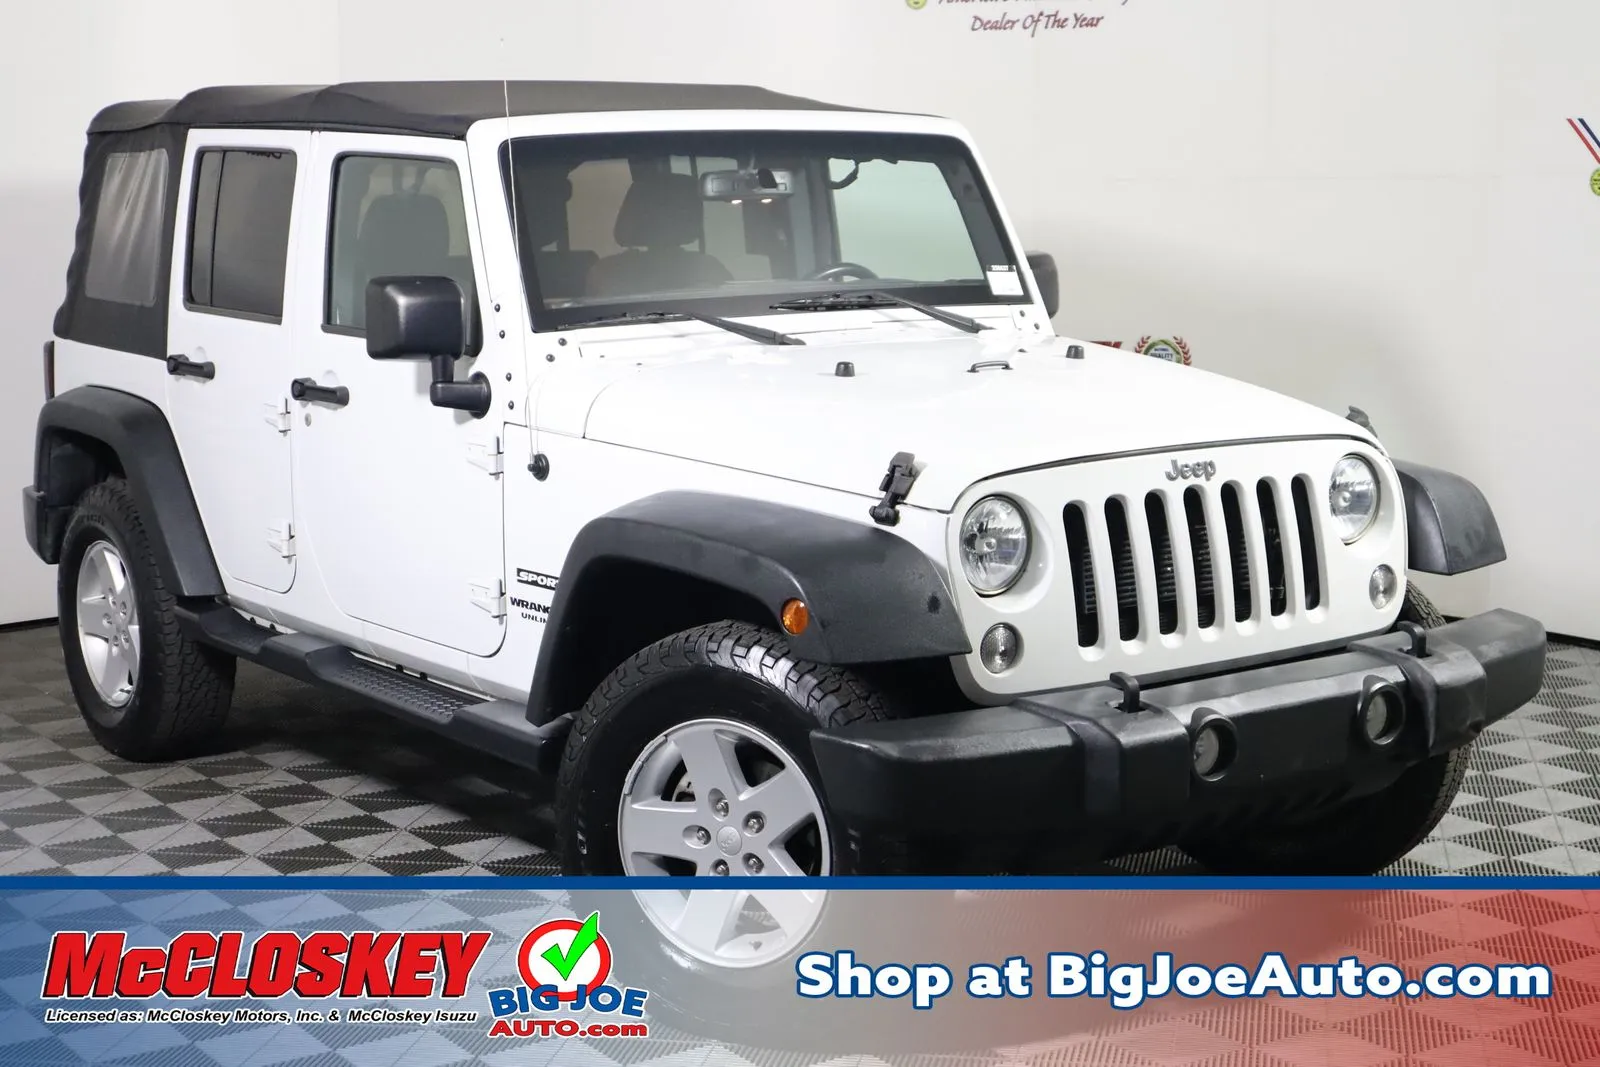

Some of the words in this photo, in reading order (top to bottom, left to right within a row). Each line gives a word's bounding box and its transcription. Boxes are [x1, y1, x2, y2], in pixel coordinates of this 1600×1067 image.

[971, 12, 1020, 31] Dealer
[1022, 11, 1044, 38] Of
[1044, 10, 1069, 29] The
[1072, 12, 1105, 29] Year
[1165, 459, 1216, 481] Jeep
